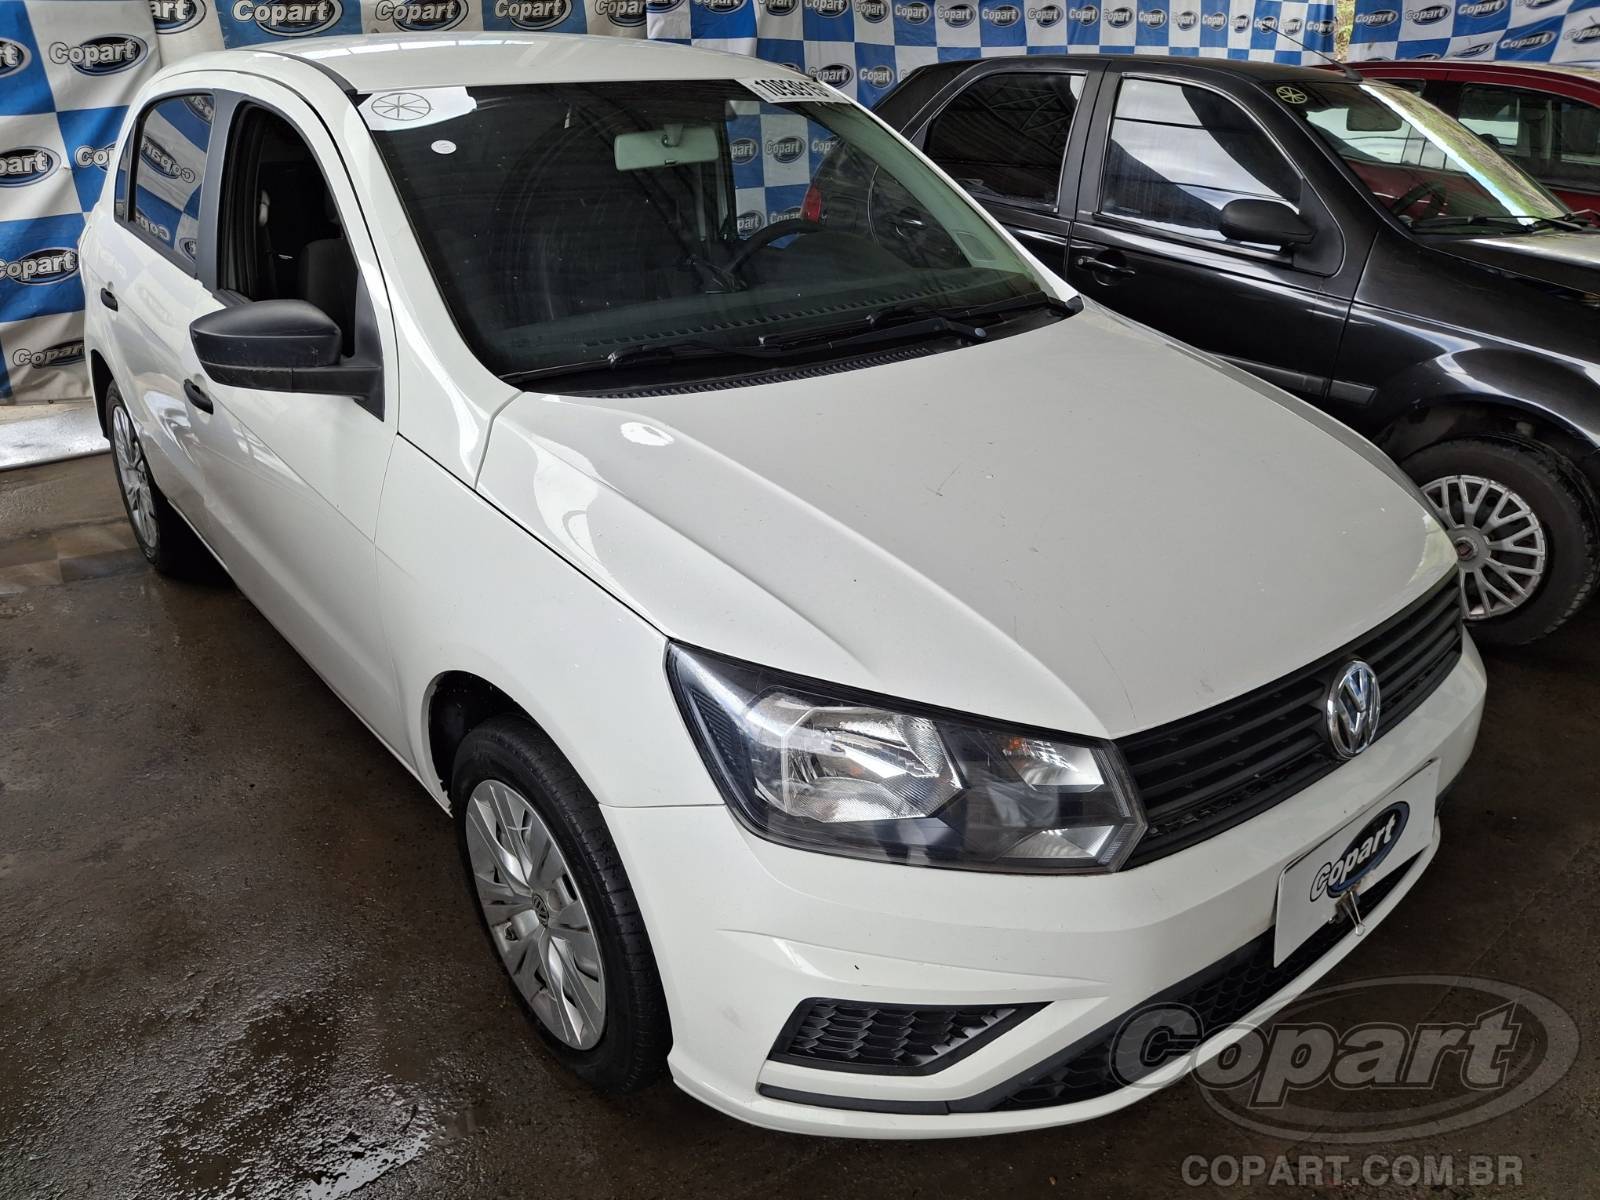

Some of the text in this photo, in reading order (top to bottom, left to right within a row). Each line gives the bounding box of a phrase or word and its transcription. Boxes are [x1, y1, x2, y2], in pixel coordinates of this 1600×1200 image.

[232, 0, 330, 26] Copart
[375, 0, 456, 25] Copart
[495, 0, 562, 22] Copart
[854, 1, 885, 16] Copart
[895, 4, 927, 20] Copart
[937, 6, 970, 22] Copart
[982, 8, 1018, 23] Copart
[1027, 8, 1058, 23] Copart
[1069, 9, 1096, 21] Copart
[1405, 7, 1446, 21] Copart
[1458, 0, 1501, 15] Copart
[1139, 11, 1164, 23] Copart
[1355, 12, 1394, 23] Copart
[1500, 32, 1548, 48] Copart
[50, 39, 136, 68] Copart
[860, 67, 890, 84] Copart
[764, 139, 800, 156] Copart
[1309, 812, 1397, 902] Copart
